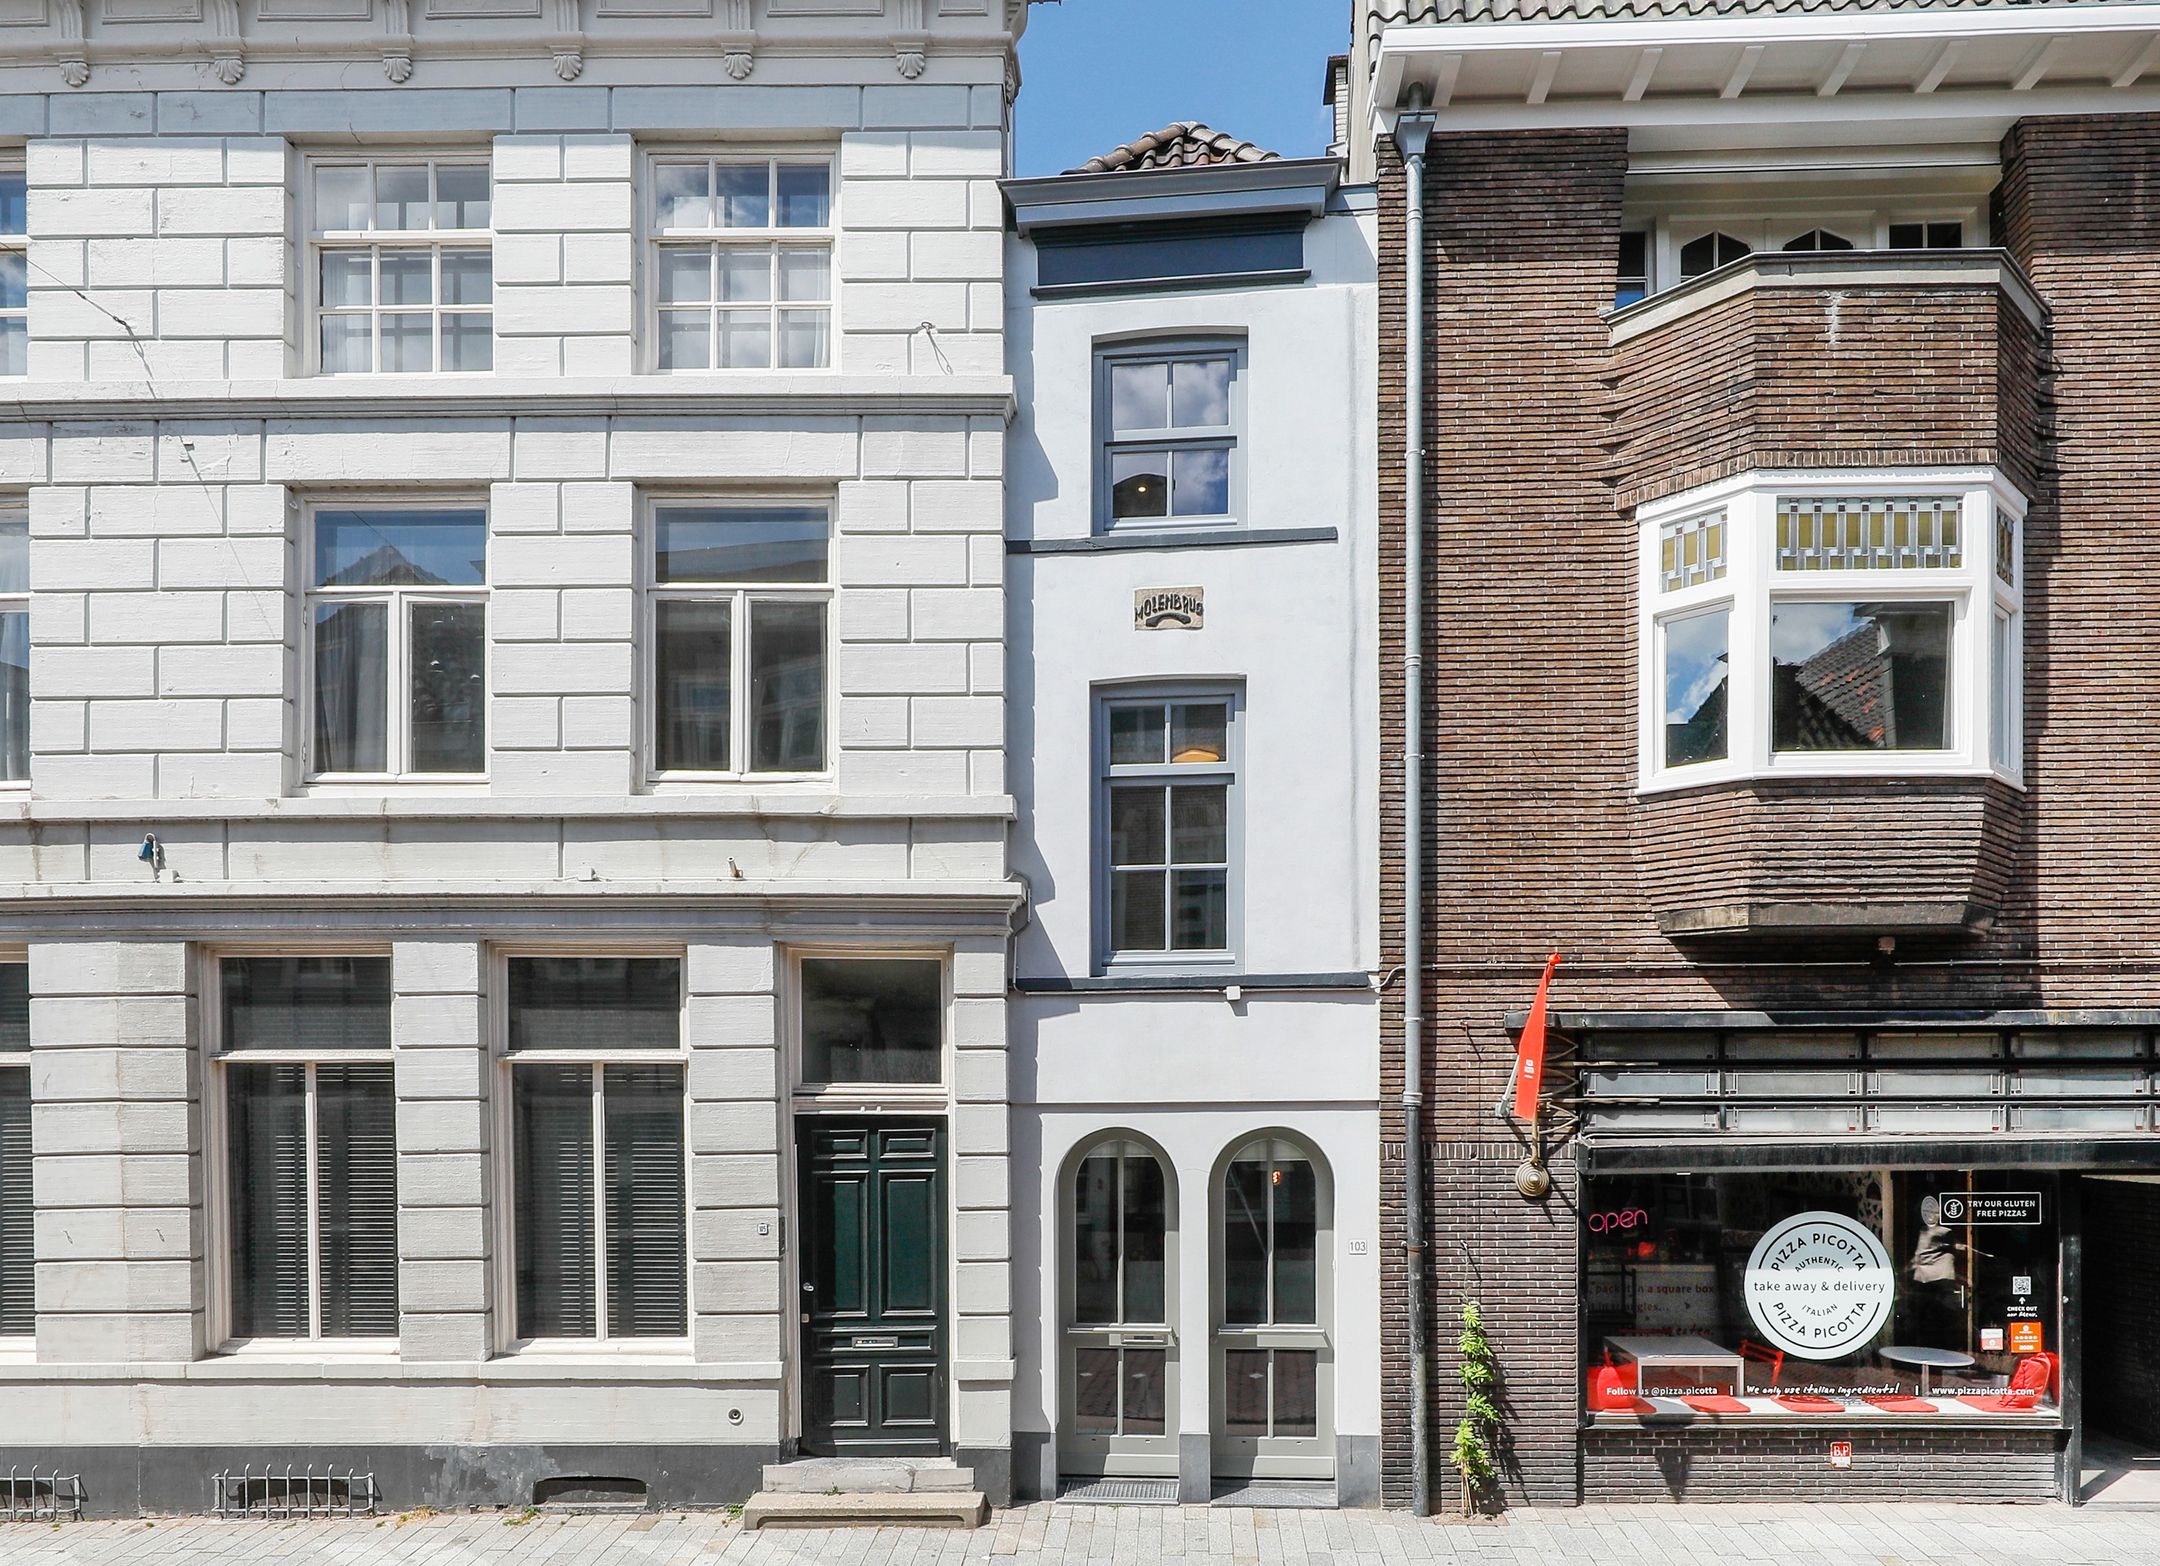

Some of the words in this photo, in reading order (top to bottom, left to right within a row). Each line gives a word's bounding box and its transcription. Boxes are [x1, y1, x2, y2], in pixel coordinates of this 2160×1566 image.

[1967, 1200, 1982, 1208] TRY
[1984, 1200, 2002, 1208] OUR
[2003, 1200, 2036, 1208] GLUTEN
[1588, 1209, 1648, 1234] open
[1350, 1241, 1366, 1251] 103
[1771, 1237, 1807, 1271] PIZZA
[1812, 1233, 1867, 1271] PICOTTA
[1794, 1256, 1844, 1273] AUTHENTIC
[1754, 1281, 1781, 1291] take
[1784, 1283, 1817, 1294] away
[1821, 1281, 1830, 1291] &
[1833, 1281, 1886, 1294] delivery
[1801, 1303, 1838, 1317] ITALIAN
[1773, 1302, 1806, 1336] PIZZA
[1814, 1302, 1867, 1338] PICOTTA
[1606, 1386, 1636, 1395] Follow
[1651, 1386, 1718, 1397] @pizza.picotta
[1746, 1385, 1760, 1394] We
[1762, 1385, 1781, 1399] only
[1784, 1386, 1800, 1394] use
[1838, 1382, 1900, 1397] ingredients!
[1932, 1386, 2035, 1397] www.pizzapicotta.com
